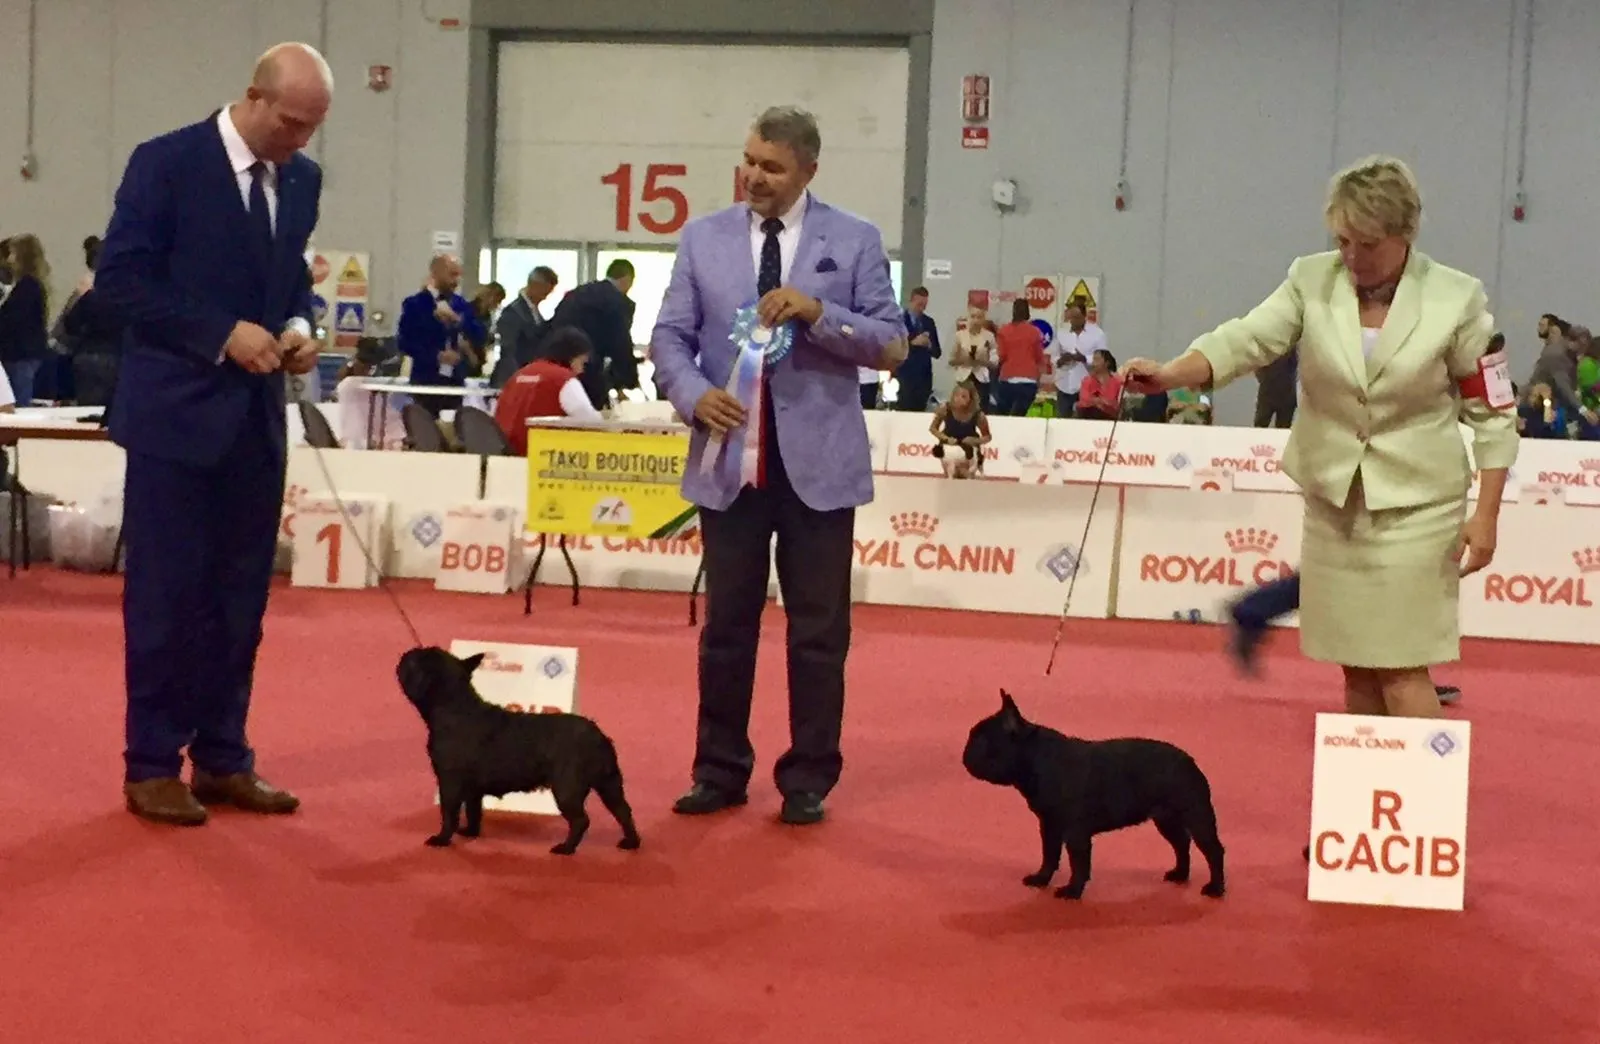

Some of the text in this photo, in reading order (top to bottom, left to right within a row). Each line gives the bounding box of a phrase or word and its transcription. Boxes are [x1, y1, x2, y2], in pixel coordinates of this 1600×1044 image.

[600, 163, 689, 234] 15
[1026, 287, 1056, 301] STOP
[1055, 449, 1156, 467] ROYAL CANIN
[1538, 472, 1588, 486] ROYAL
[316, 523, 342, 584] 1
[441, 542, 505, 573] BOB
[853, 539, 1015, 575] YAL CANIN
[1140, 554, 1244, 586] ROYAL
[1485, 573, 1593, 607] ROYAL
[1323, 735, 1406, 750] ROYAL CANIN
[1372, 789, 1402, 831] R
[1315, 831, 1460, 877] CACIB
